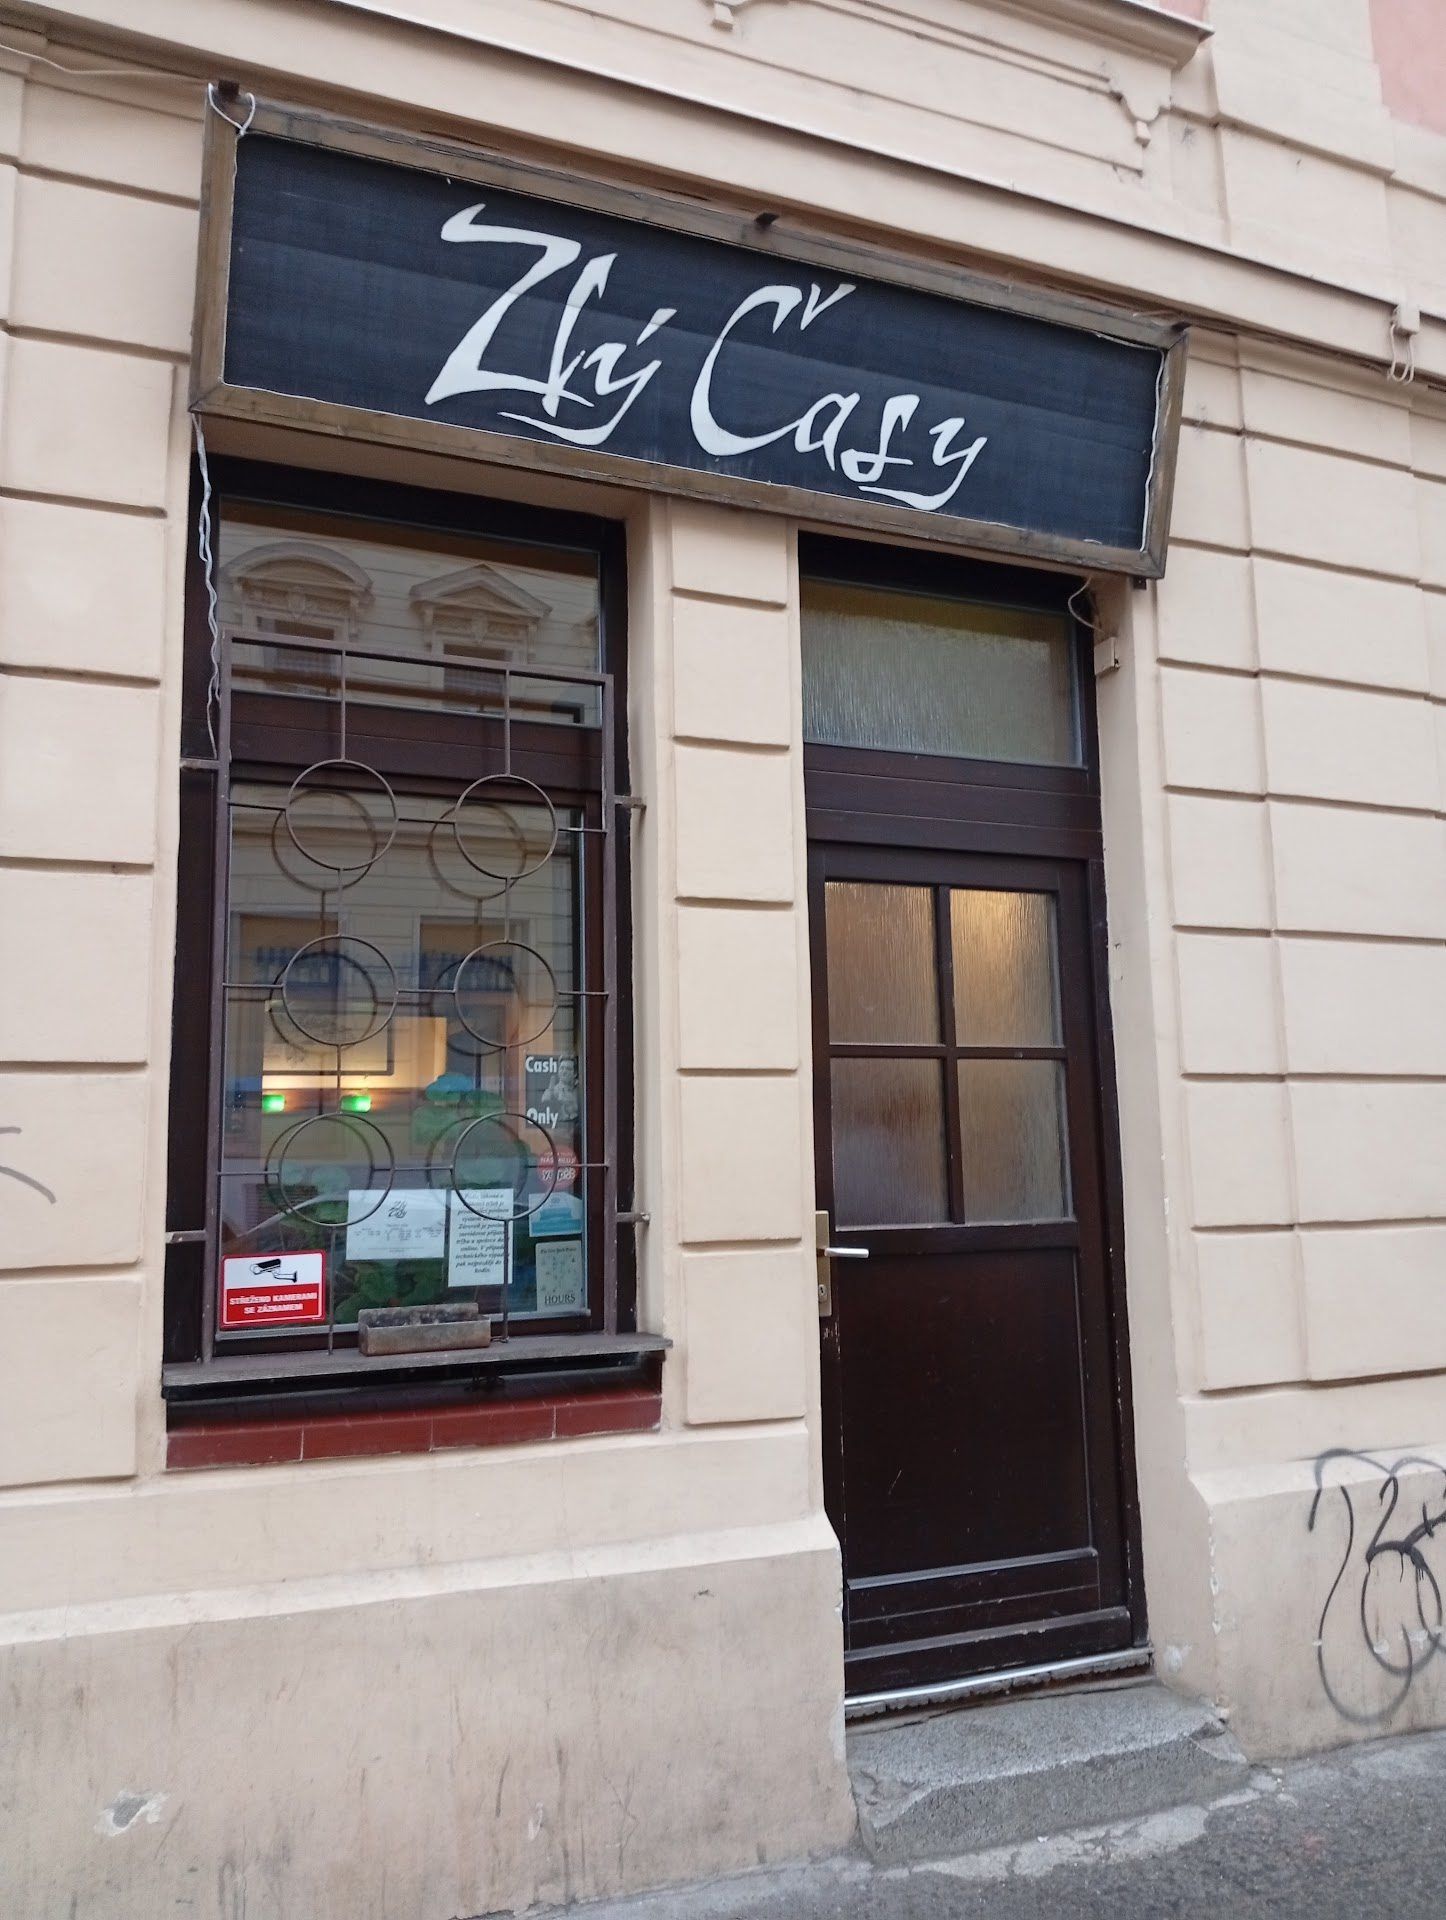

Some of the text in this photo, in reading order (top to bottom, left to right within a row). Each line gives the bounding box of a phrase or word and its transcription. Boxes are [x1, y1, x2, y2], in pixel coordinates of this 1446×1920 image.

[424, 203, 988, 511] Zlý Časy
[525, 1056, 558, 1073] Cash
[527, 1106, 559, 1129] Only
[544, 1293, 576, 1305] HOURS
